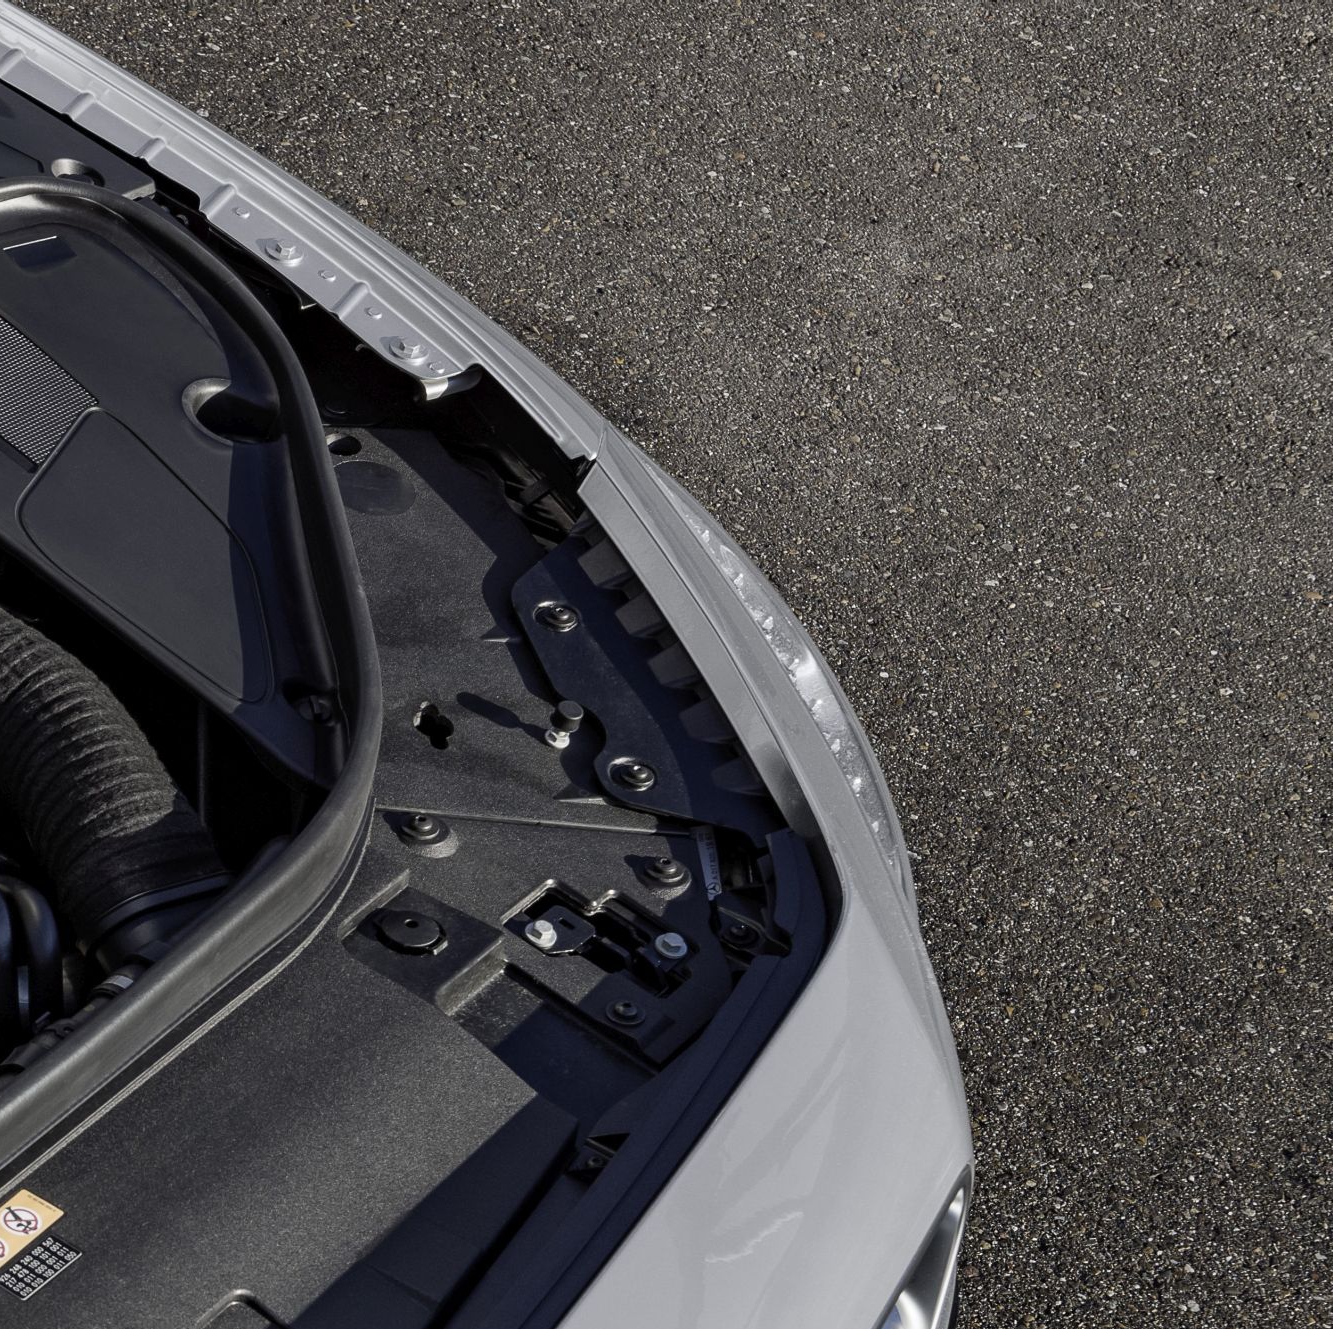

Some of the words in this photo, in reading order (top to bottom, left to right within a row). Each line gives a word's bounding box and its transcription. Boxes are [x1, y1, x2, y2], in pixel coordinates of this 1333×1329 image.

[5, 1276, 18, 1288] 217
[39, 1250, 52, 1260] 101
[23, 1273, 36, 1283] 011
